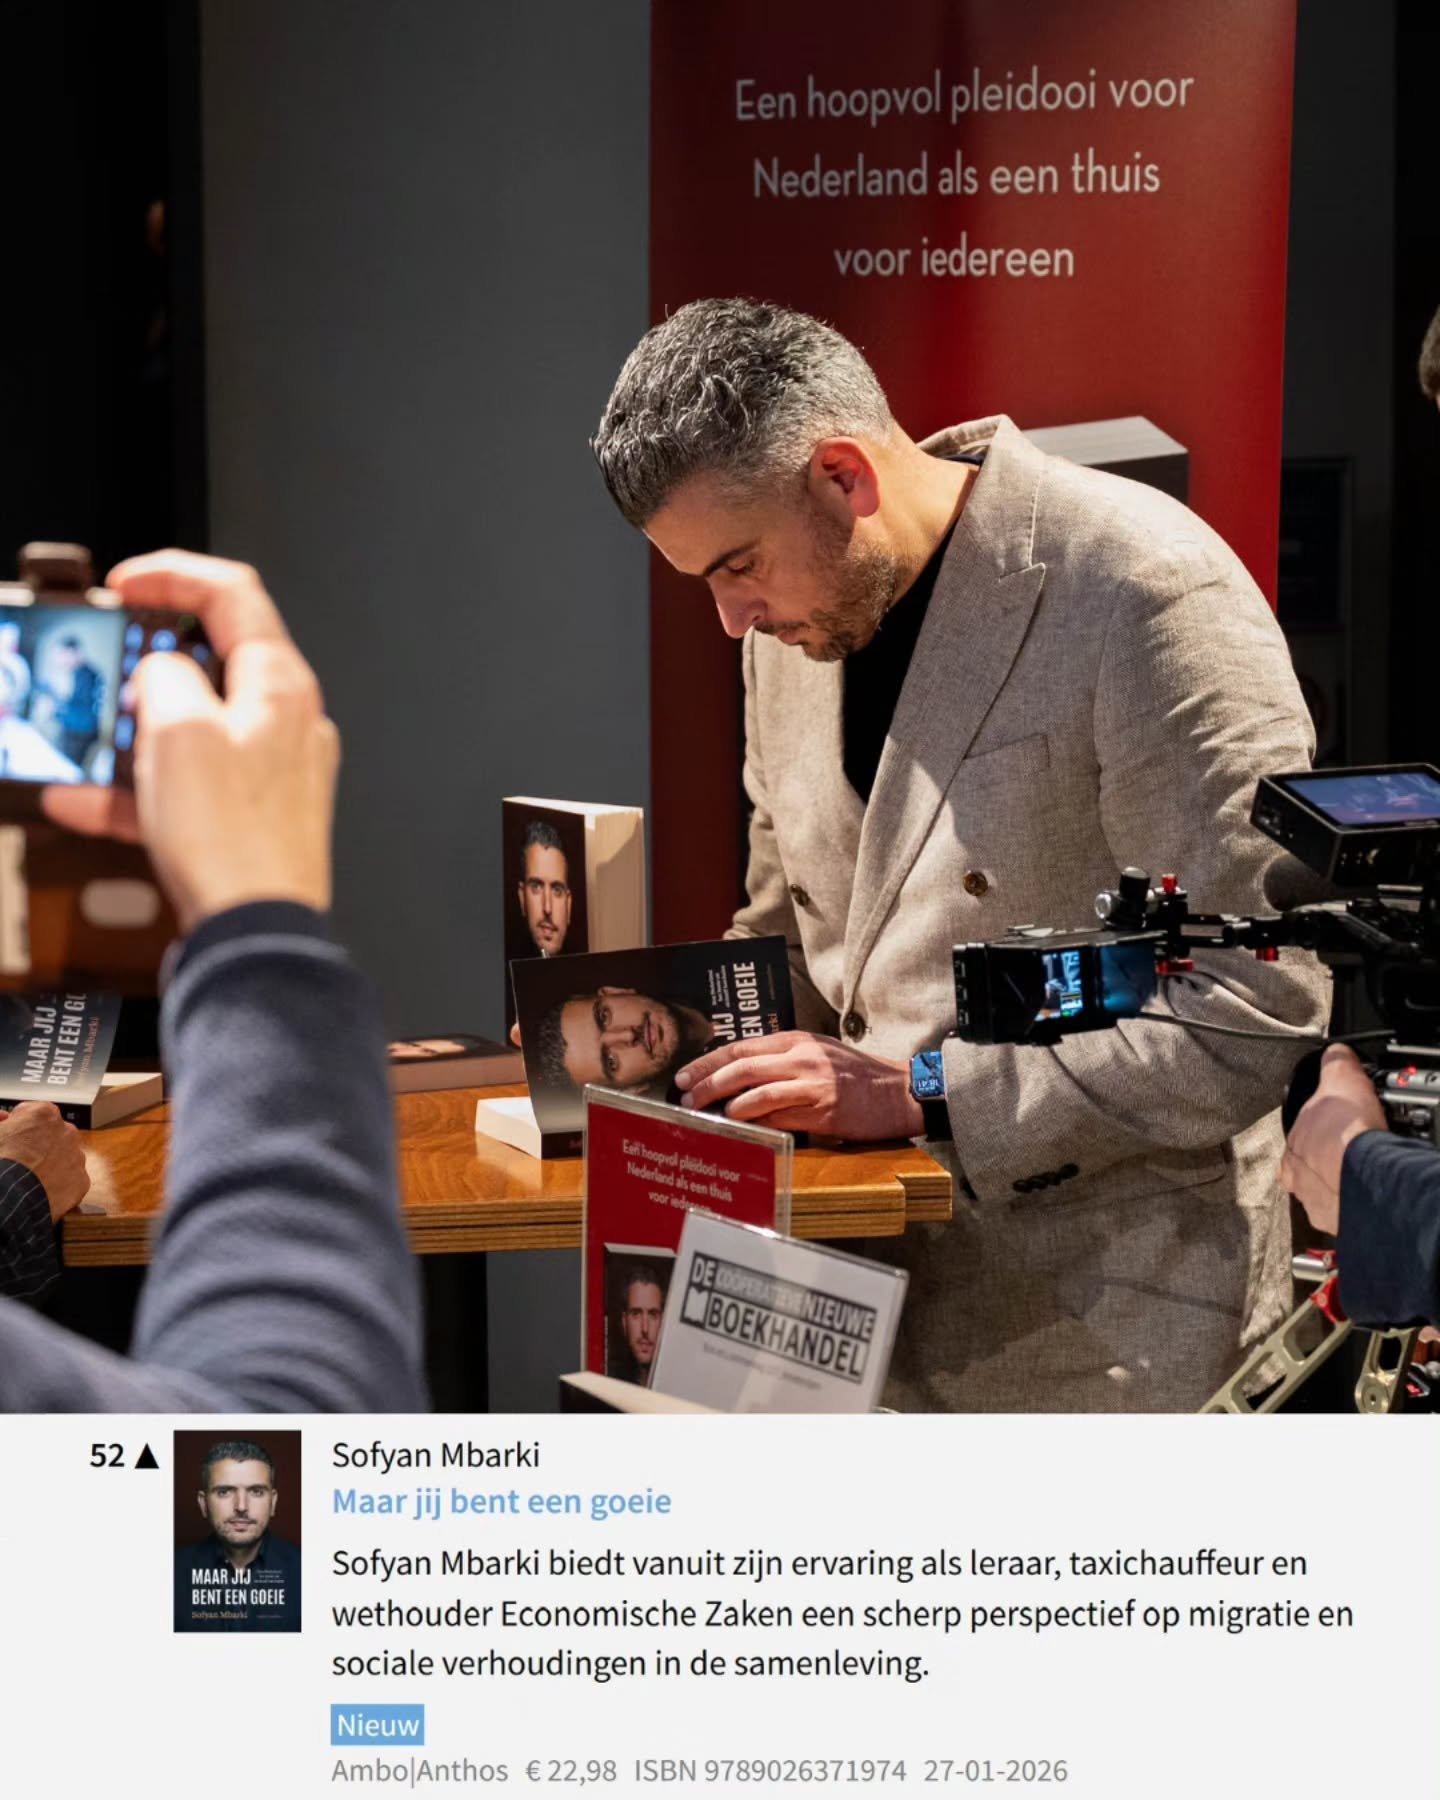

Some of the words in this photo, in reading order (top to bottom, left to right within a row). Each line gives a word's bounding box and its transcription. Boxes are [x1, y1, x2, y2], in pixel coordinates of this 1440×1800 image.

[736, 79, 797, 120] Een
[808, 74, 941, 127] hoopvol
[952, 64, 1096, 124] pleidooi
[1109, 77, 1195, 108] voor
[754, 152, 928, 198] Nederland
[938, 149, 979, 195] als
[990, 165, 1060, 195] een
[1071, 146, 1161, 194] thuis
[833, 249, 911, 276] voor
[922, 231, 1075, 277] iedereen
[733, 961, 760, 1012] GOEIE
[33, 1006, 57, 1035] JIJ
[58, 1015, 83, 1046] EEN
[711, 1012, 737, 1041] JIJ
[740, 1015, 764, 1039] EN
[20, 1037, 52, 1083] MAAR
[47, 1047, 76, 1085] BENT
[622, 1138, 640, 1157] Een
[641, 1144, 679, 1167] hoopvol
[680, 1155, 718, 1177] pleidooi
[718, 1169, 742, 1183] voor
[627, 1161, 674, 1187] Nederland
[676, 1174, 689, 1191] als
[690, 1182, 708, 1195] een
[709, 1183, 733, 1203] thuis
[648, 1191, 669, 1205] voor
[691, 1256, 717, 1288] DE
[804, 1290, 875, 1340] NIEUWE
[708, 1297, 861, 1377] BOEKHANDEL
